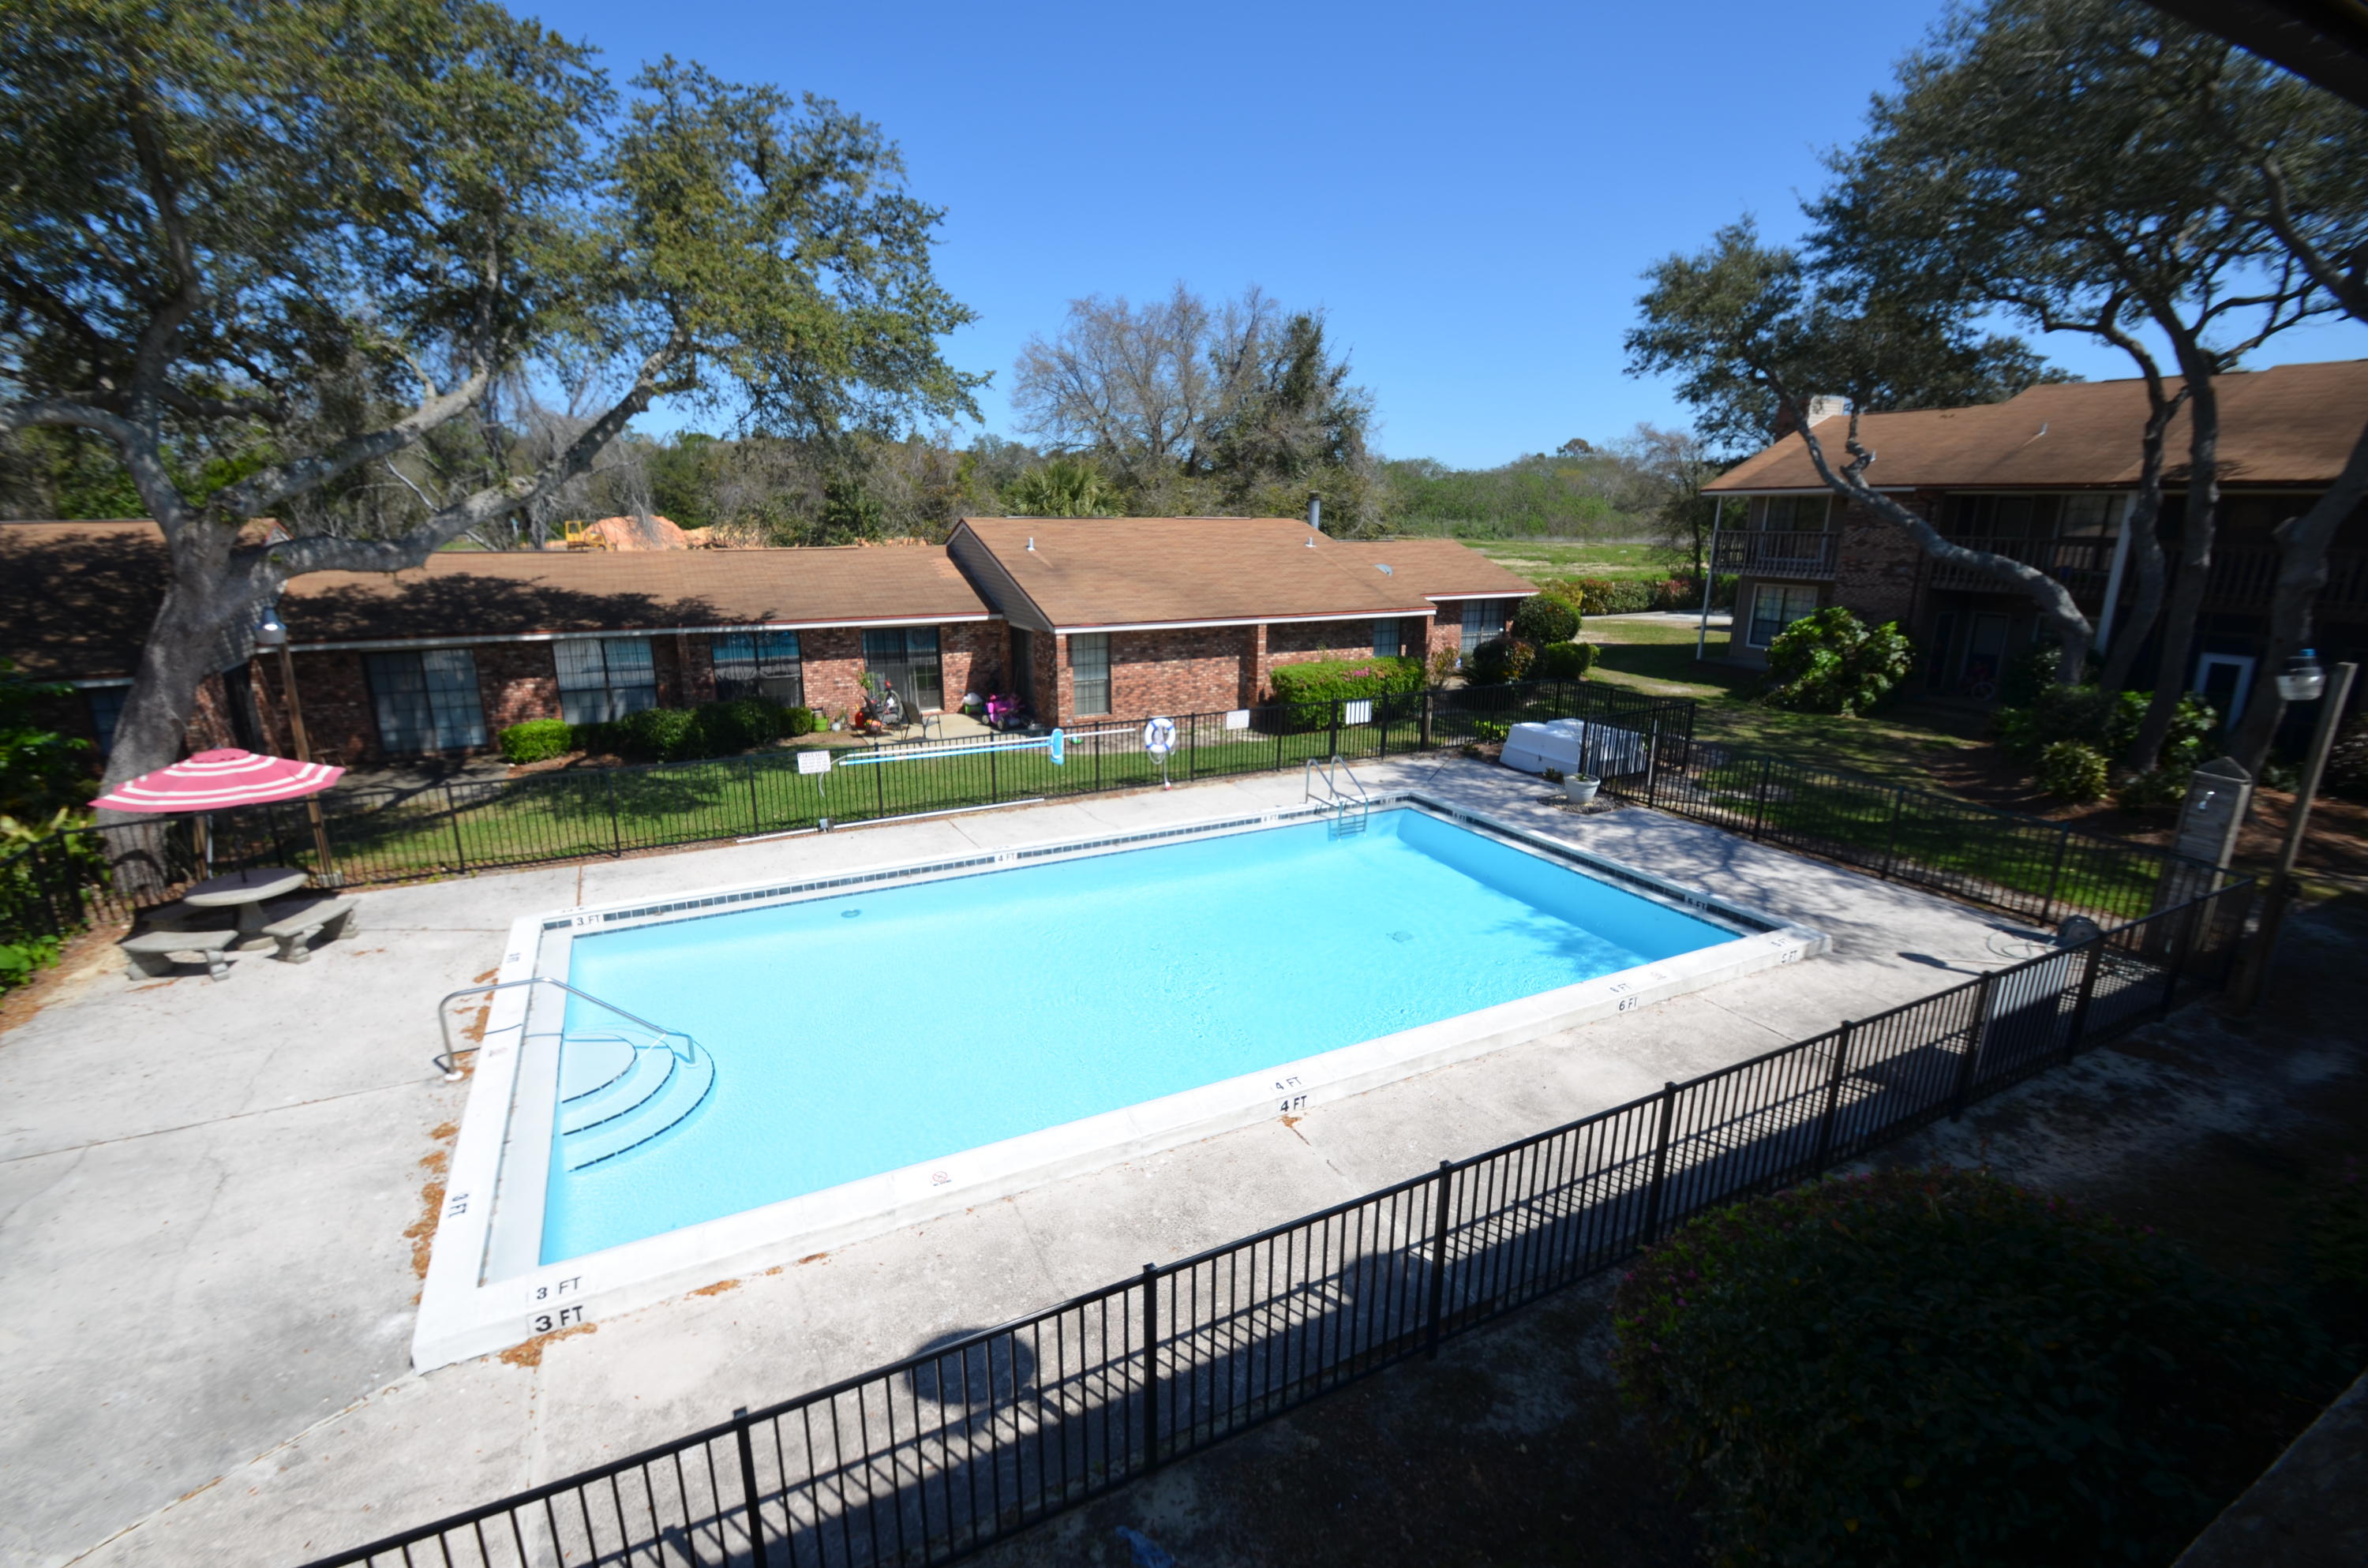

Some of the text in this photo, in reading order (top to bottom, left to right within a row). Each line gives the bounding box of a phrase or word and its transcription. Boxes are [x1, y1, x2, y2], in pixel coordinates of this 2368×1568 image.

[1006, 852, 1015, 861] FT
[1696, 900, 1706, 909] FT
[577, 914, 600, 926] 3 FT
[1789, 949, 1797, 960] FT
[1619, 997, 1638, 1011] 6 FT
[1276, 1076, 1302, 1091] 4 FT
[1280, 1095, 1307, 1112] 4 FT
[448, 1203, 466, 1218] FT
[537, 1275, 582, 1300] 3 FT
[534, 1304, 583, 1333] 3 FT
